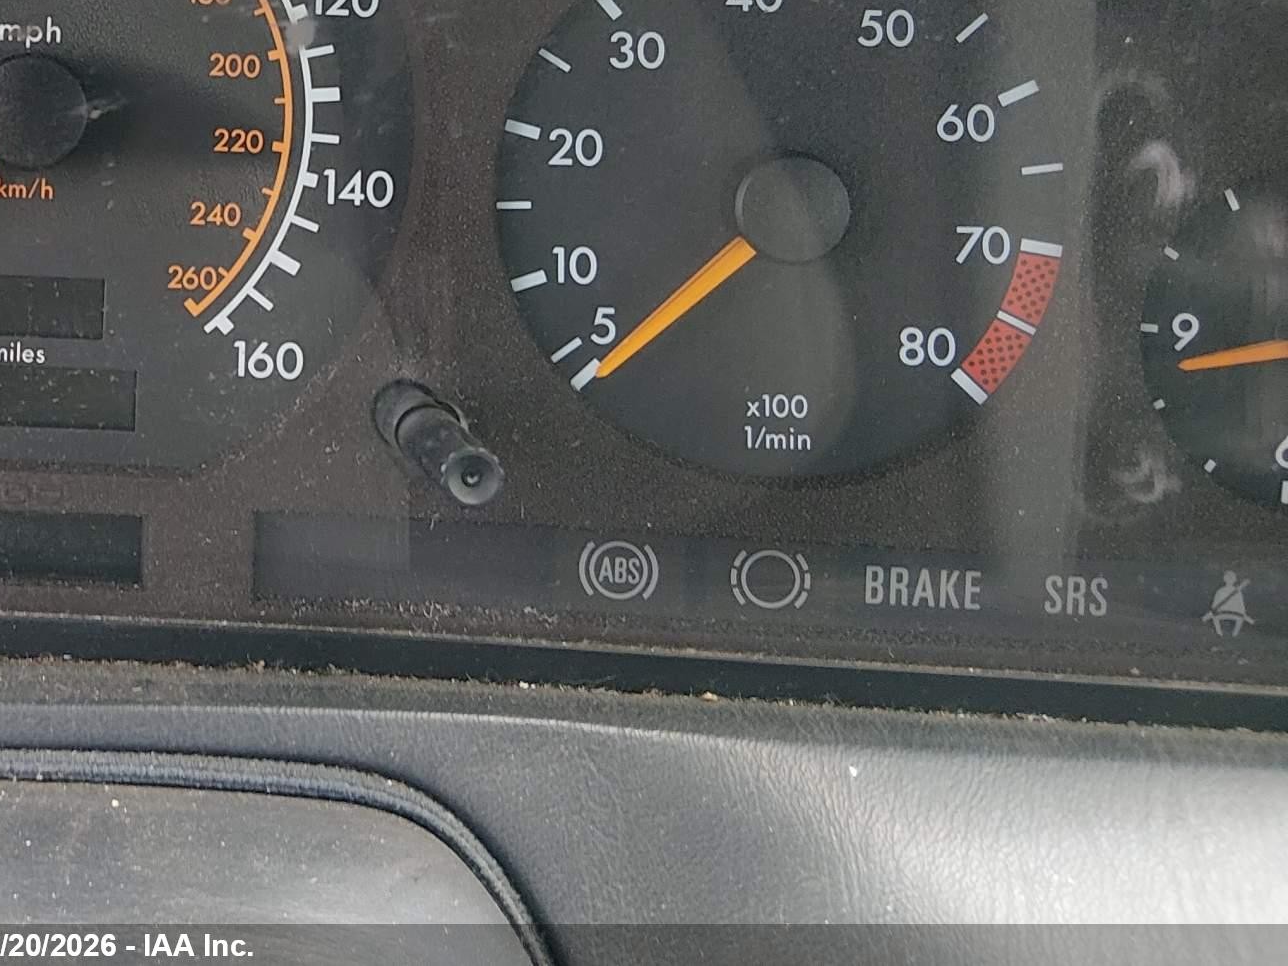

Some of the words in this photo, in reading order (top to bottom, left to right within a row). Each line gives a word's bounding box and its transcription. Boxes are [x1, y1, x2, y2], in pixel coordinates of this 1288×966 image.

[0, 16, 61, 49] mph
[858, 10, 914, 47] 50
[210, 53, 261, 78] 200
[610, 32, 664, 68] 30
[216, 128, 264, 153] 220
[937, 104, 994, 142] 60
[549, 129, 602, 166] 20
[324, 169, 393, 207] 140
[192, 202, 239, 225] 240
[956, 226, 1010, 264] 70
[168, 265, 217, 290] 260
[553, 247, 597, 284] 10
[591, 308, 615, 344] 5
[1172, 313, 1199, 350] 9
[234, 341, 303, 379] 160
[900, 327, 955, 366] 80
[747, 395, 807, 418] x100
[745, 426, 810, 450] 1/min
[599, 556, 640, 584] ABS
[866, 566, 981, 610] BRAKE
[1045, 576, 1107, 616] SRS
